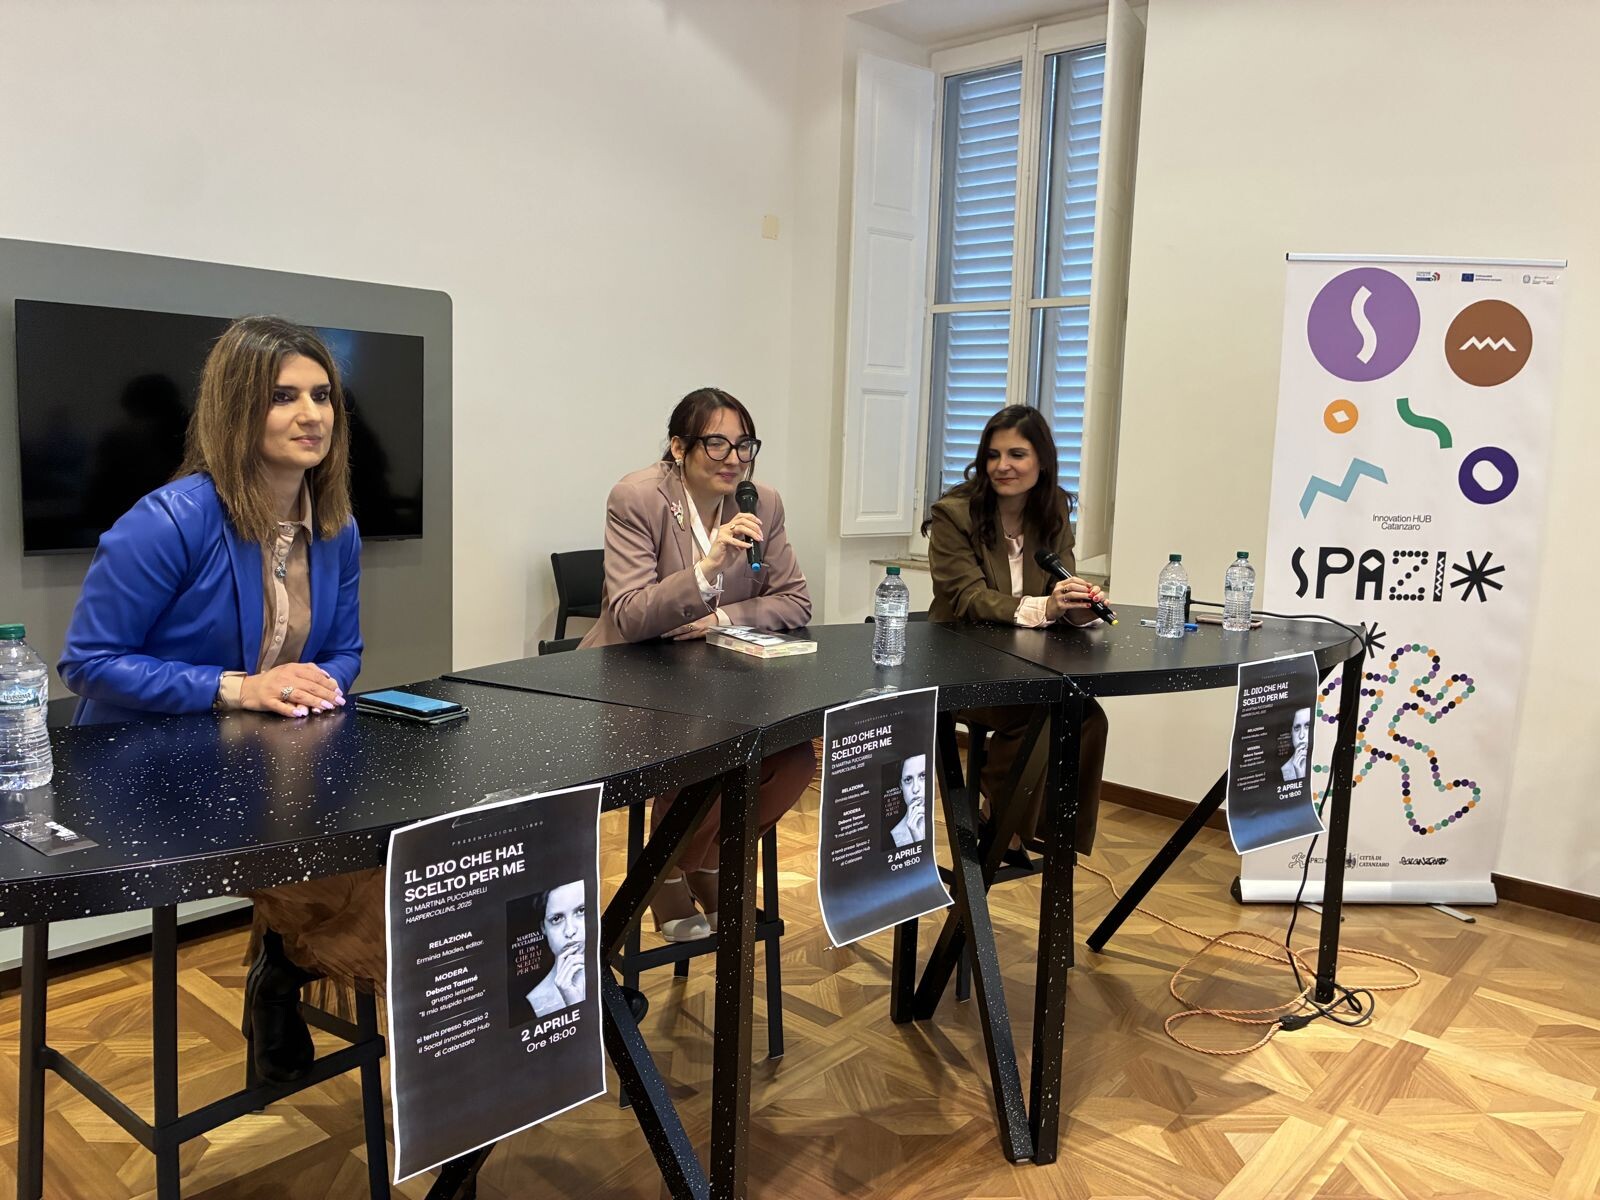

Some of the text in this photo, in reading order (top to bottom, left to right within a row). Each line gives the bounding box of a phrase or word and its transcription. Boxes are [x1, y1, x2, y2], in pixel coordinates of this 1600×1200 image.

[1372, 514, 1432, 523] Innovation HUB
[1381, 522, 1421, 531] Catanzaro
[1251, 686, 1263, 695] DIO
[1263, 684, 1276, 693] CHE
[1277, 682, 1288, 690] HAI
[1242, 691, 1288, 706] SCELTO PER ME
[832, 724, 892, 749] IL DIO CHE HAI
[832, 736, 892, 762] SCELTO PER ME
[1282, 781, 1303, 792] APRILE
[887, 845, 922, 863] 2 APRILE
[404, 843, 524, 884] IL DIO CHE HAI
[891, 856, 920, 871] Ore 18:00
[404, 860, 525, 902] SCELTO PER ME
[405, 886, 488, 914] DI MARTINA PUCCIARELLI
[457, 900, 473, 910] 2025
[429, 931, 472, 949] RELAZIONA
[435, 966, 468, 982] MODERA
[426, 984, 452, 997] Debora
[431, 986, 474, 1006] gruppo lettura
[440, 999, 462, 1011] stupido
[440, 1023, 461, 1036] presso
[463, 1015, 483, 1027] Spazio
[521, 1009, 580, 1042] 2 APRILE
[424, 1040, 443, 1051] Social
[477, 1022, 490, 1031] Hub
[527, 1026, 577, 1053] Ore 18:00
